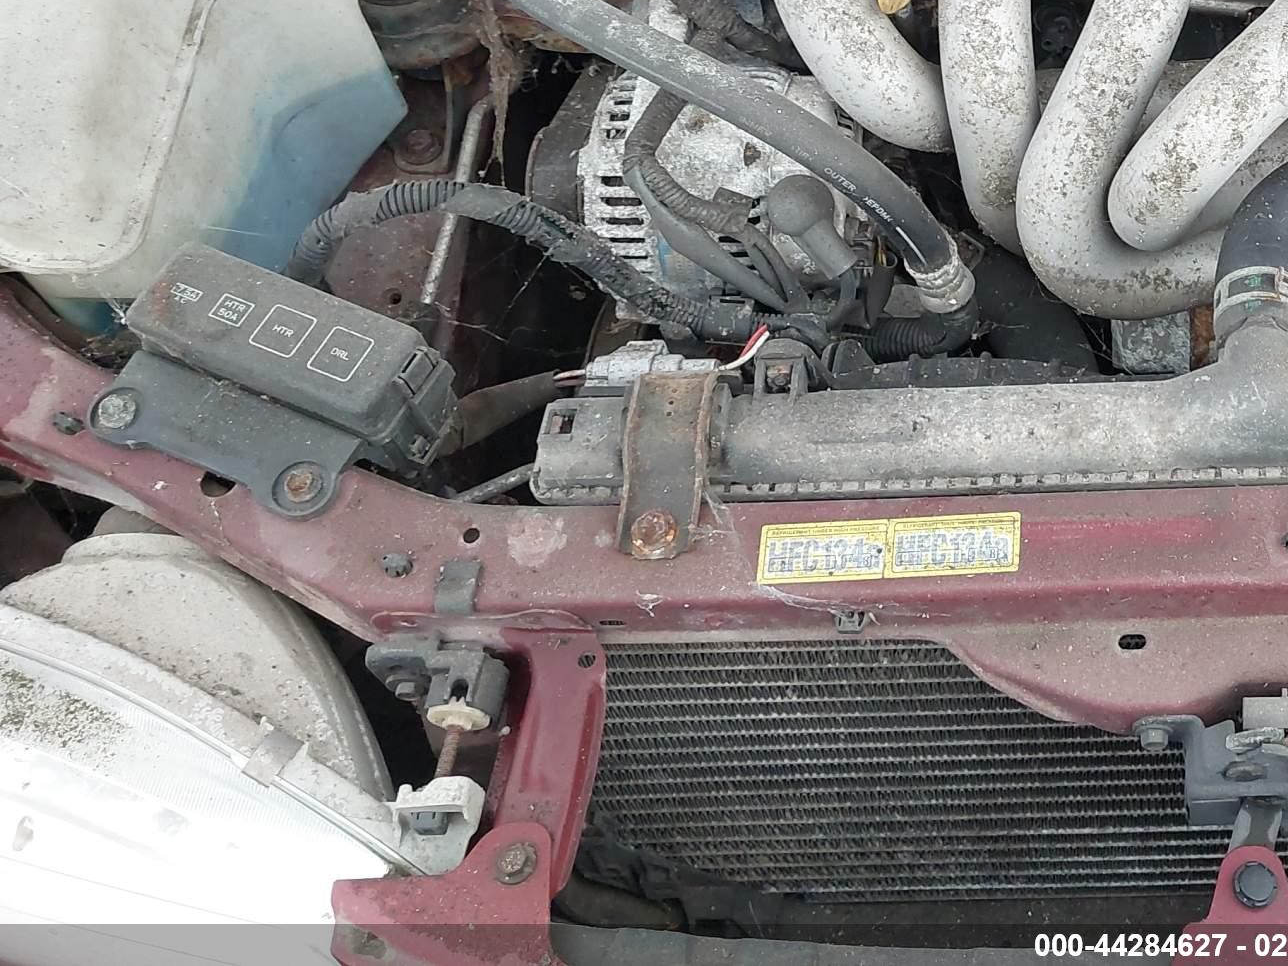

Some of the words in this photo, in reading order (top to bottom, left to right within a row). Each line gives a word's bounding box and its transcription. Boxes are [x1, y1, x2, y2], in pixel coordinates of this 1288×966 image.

[823, 167, 857, 193] OUTER
[223, 299, 247, 313] HTR
[217, 307, 240, 321] 50A
[271, 323, 295, 338] HTR
[330, 347, 350, 361] DRL
